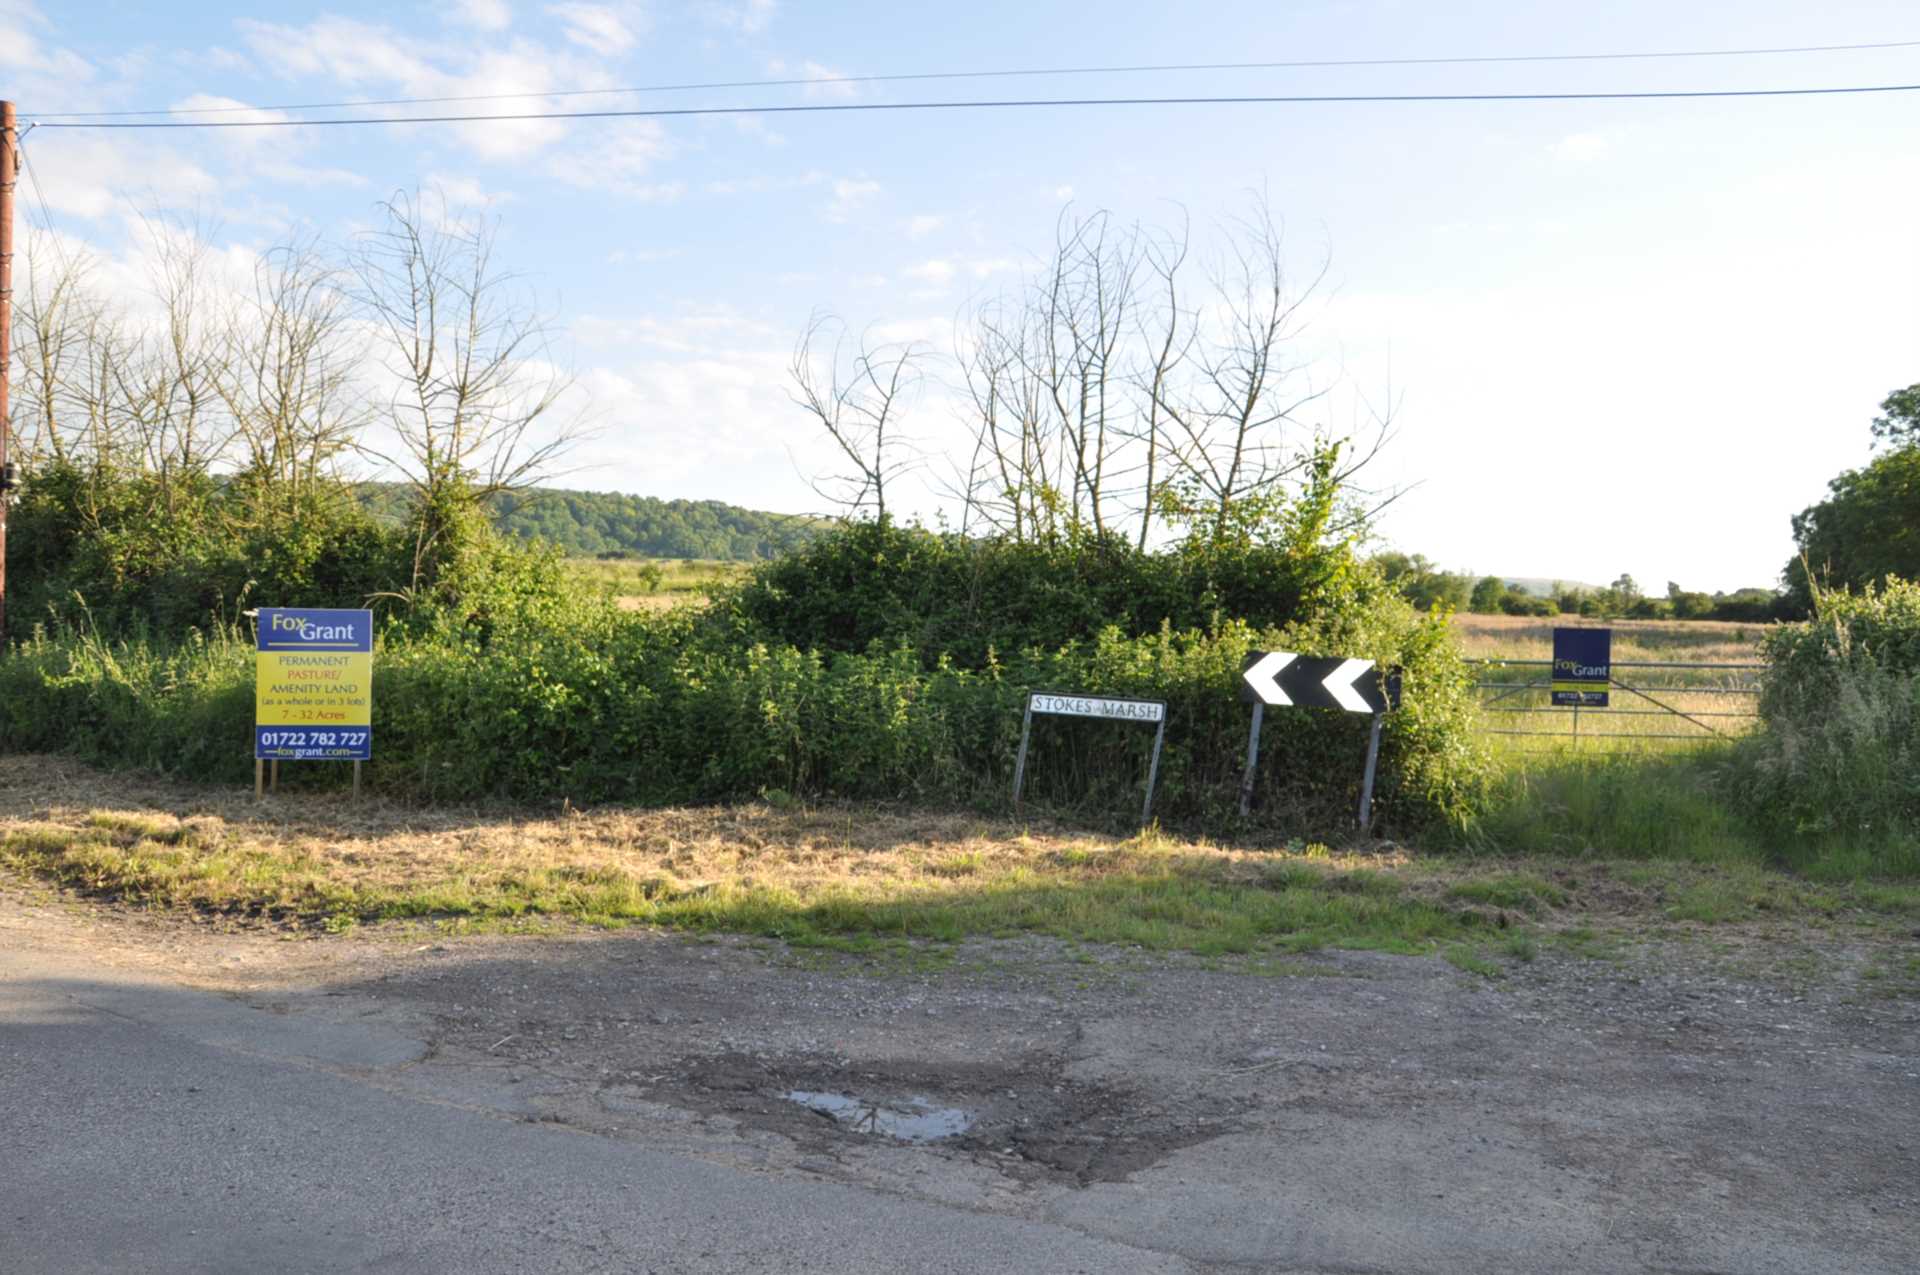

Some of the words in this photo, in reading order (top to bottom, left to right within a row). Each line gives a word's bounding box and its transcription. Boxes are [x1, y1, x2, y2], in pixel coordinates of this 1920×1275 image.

[279, 655, 350, 666] PERMANENT
[287, 670, 342, 681] PASTURE/
[271, 684, 321, 694] AMENITY
[325, 684, 358, 694] LAND
[285, 696, 313, 705] whole
[327, 696, 336, 705] in
[1034, 696, 1093, 713] STOKES
[1101, 702, 1158, 717] MARSH
[282, 709, 289, 720] 7
[300, 710, 313, 720] 32
[315, 710, 346, 720] Acres
[261, 732, 306, 746] 01722
[309, 732, 337, 746] 782
[340, 732, 367, 746] 727
